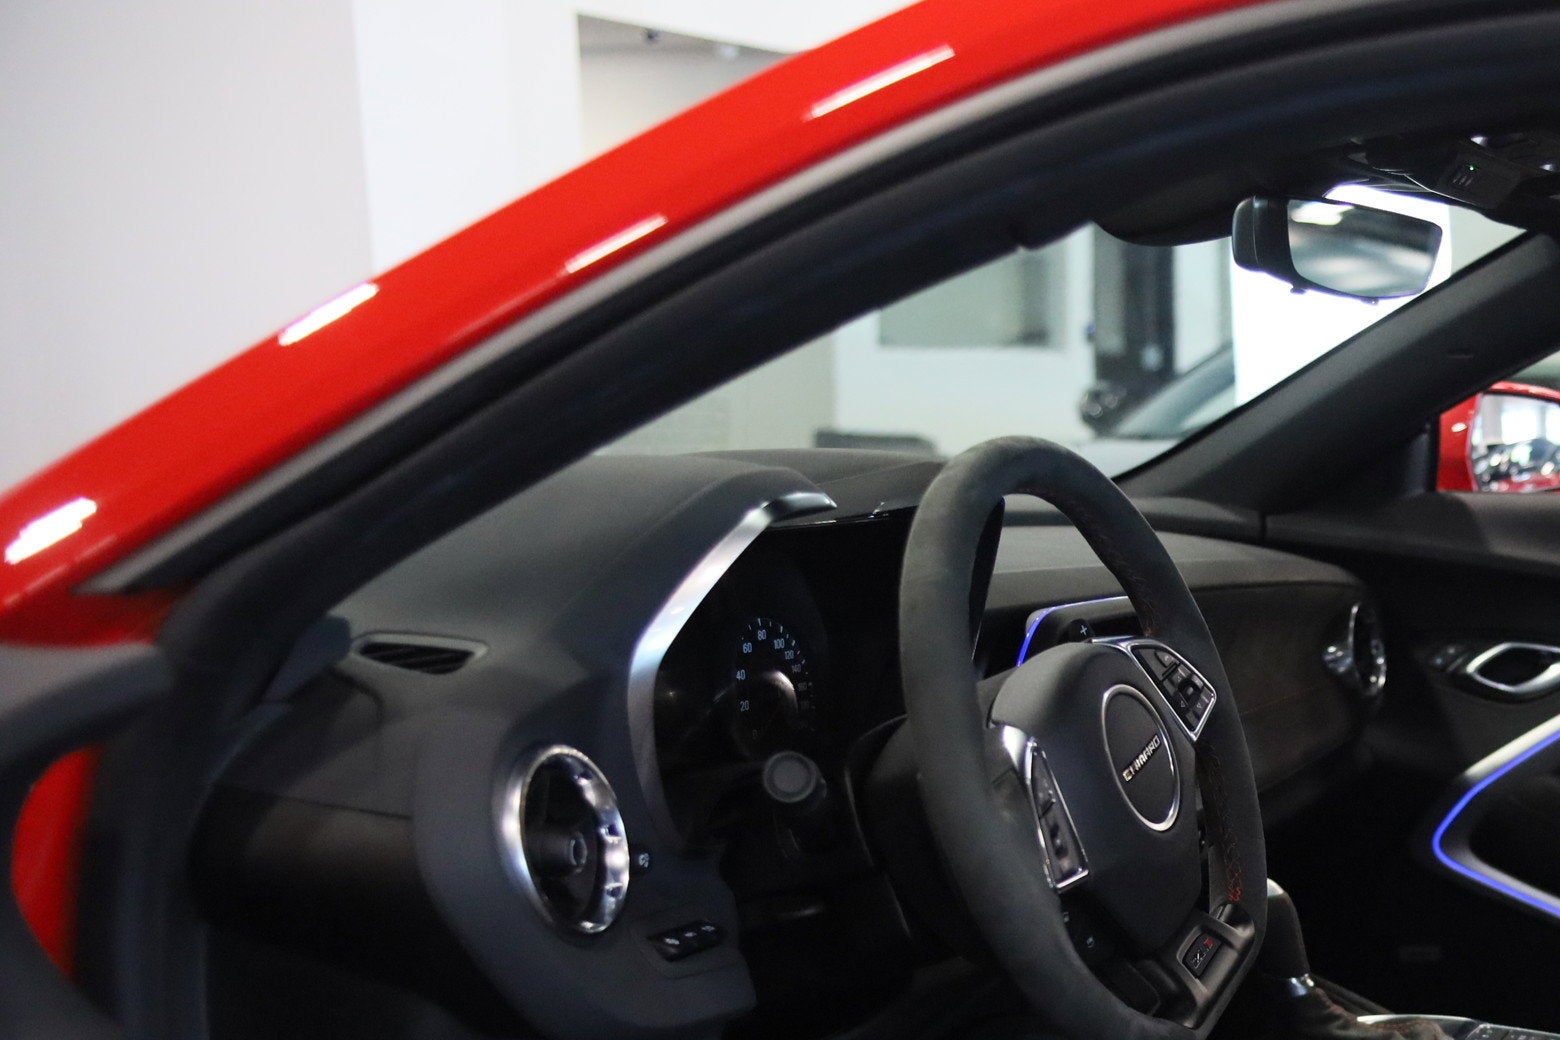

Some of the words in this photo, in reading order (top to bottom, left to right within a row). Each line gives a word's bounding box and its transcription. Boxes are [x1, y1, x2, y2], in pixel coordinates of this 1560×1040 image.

[757, 629, 767, 641] 80
[742, 642, 753, 654] 60
[773, 638, 785, 650] 100
[736, 669, 746, 681] 40
[739, 700, 750, 712] 20
[1121, 734, 1161, 782] CAMARO
